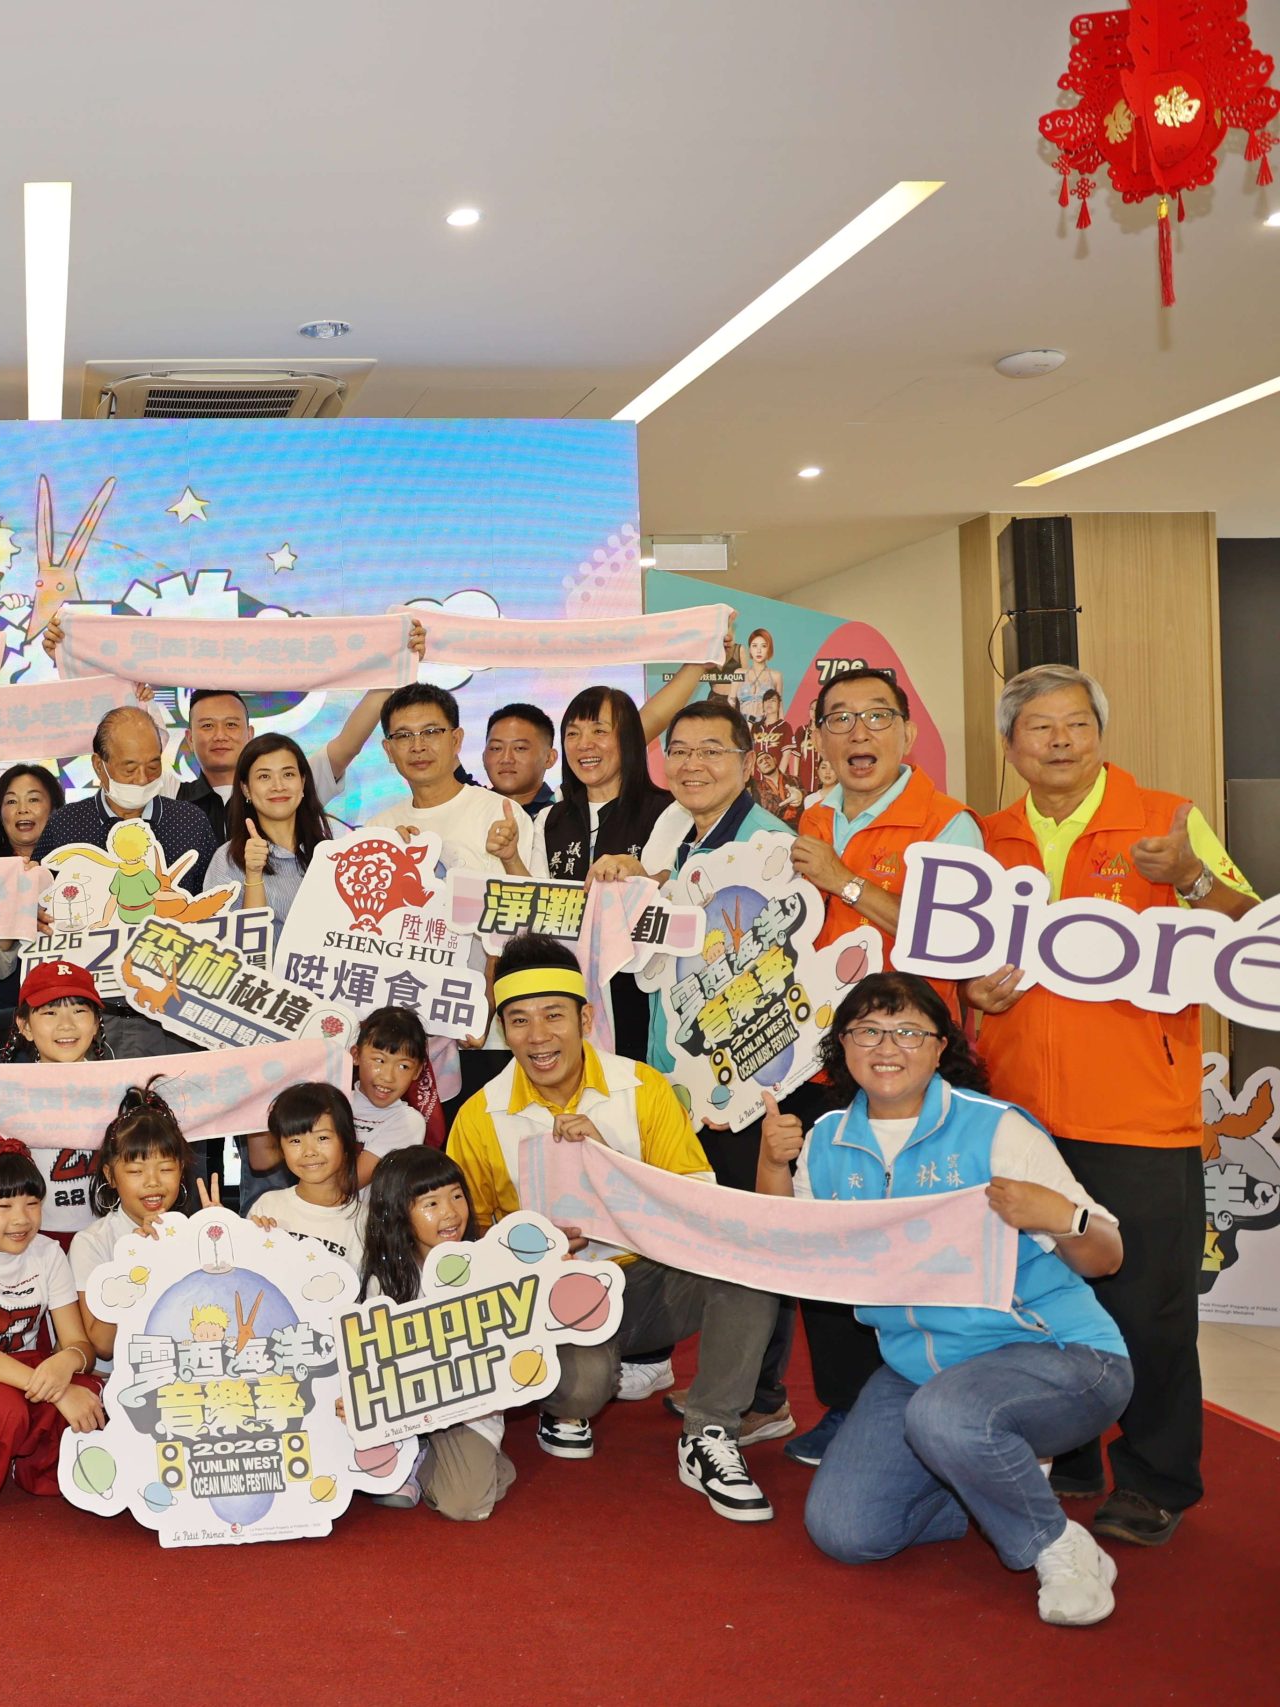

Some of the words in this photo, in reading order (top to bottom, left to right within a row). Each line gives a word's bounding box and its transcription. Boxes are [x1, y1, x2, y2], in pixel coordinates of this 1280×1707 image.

[723, 674, 744, 682] AQUA
[478, 879, 588, 941] 淨灘
[907, 855, 1280, 1012] Bioré
[56, 964, 73, 976] R
[322, 930, 404, 959] SHENG
[408, 944, 457, 967] HUI
[730, 1000, 785, 1051] 2026
[732, 1034, 766, 1064] YUNLIN
[763, 1012, 790, 1039] WEST
[738, 1058, 758, 1080] OCEAN
[771, 1024, 799, 1056] FESTIVAL
[54, 1188, 86, 1207] 22
[342, 1276, 538, 1371] Happy
[117, 1321, 336, 1409] 雲西海洋
[350, 1346, 505, 1431] Hour
[154, 1375, 306, 1440] 音樂季
[191, 1458, 240, 1475] YUNLIN
[242, 1455, 280, 1471] WEST
[192, 1438, 277, 1457] 2026
[193, 1475, 220, 1496] OCEAN
[221, 1473, 246, 1495] MUSIC
[245, 1471, 284, 1493] FESTIVAL
[172, 1531, 181, 1542] Le
[183, 1530, 199, 1541] Petit
[202, 1529, 226, 1540] Prince
